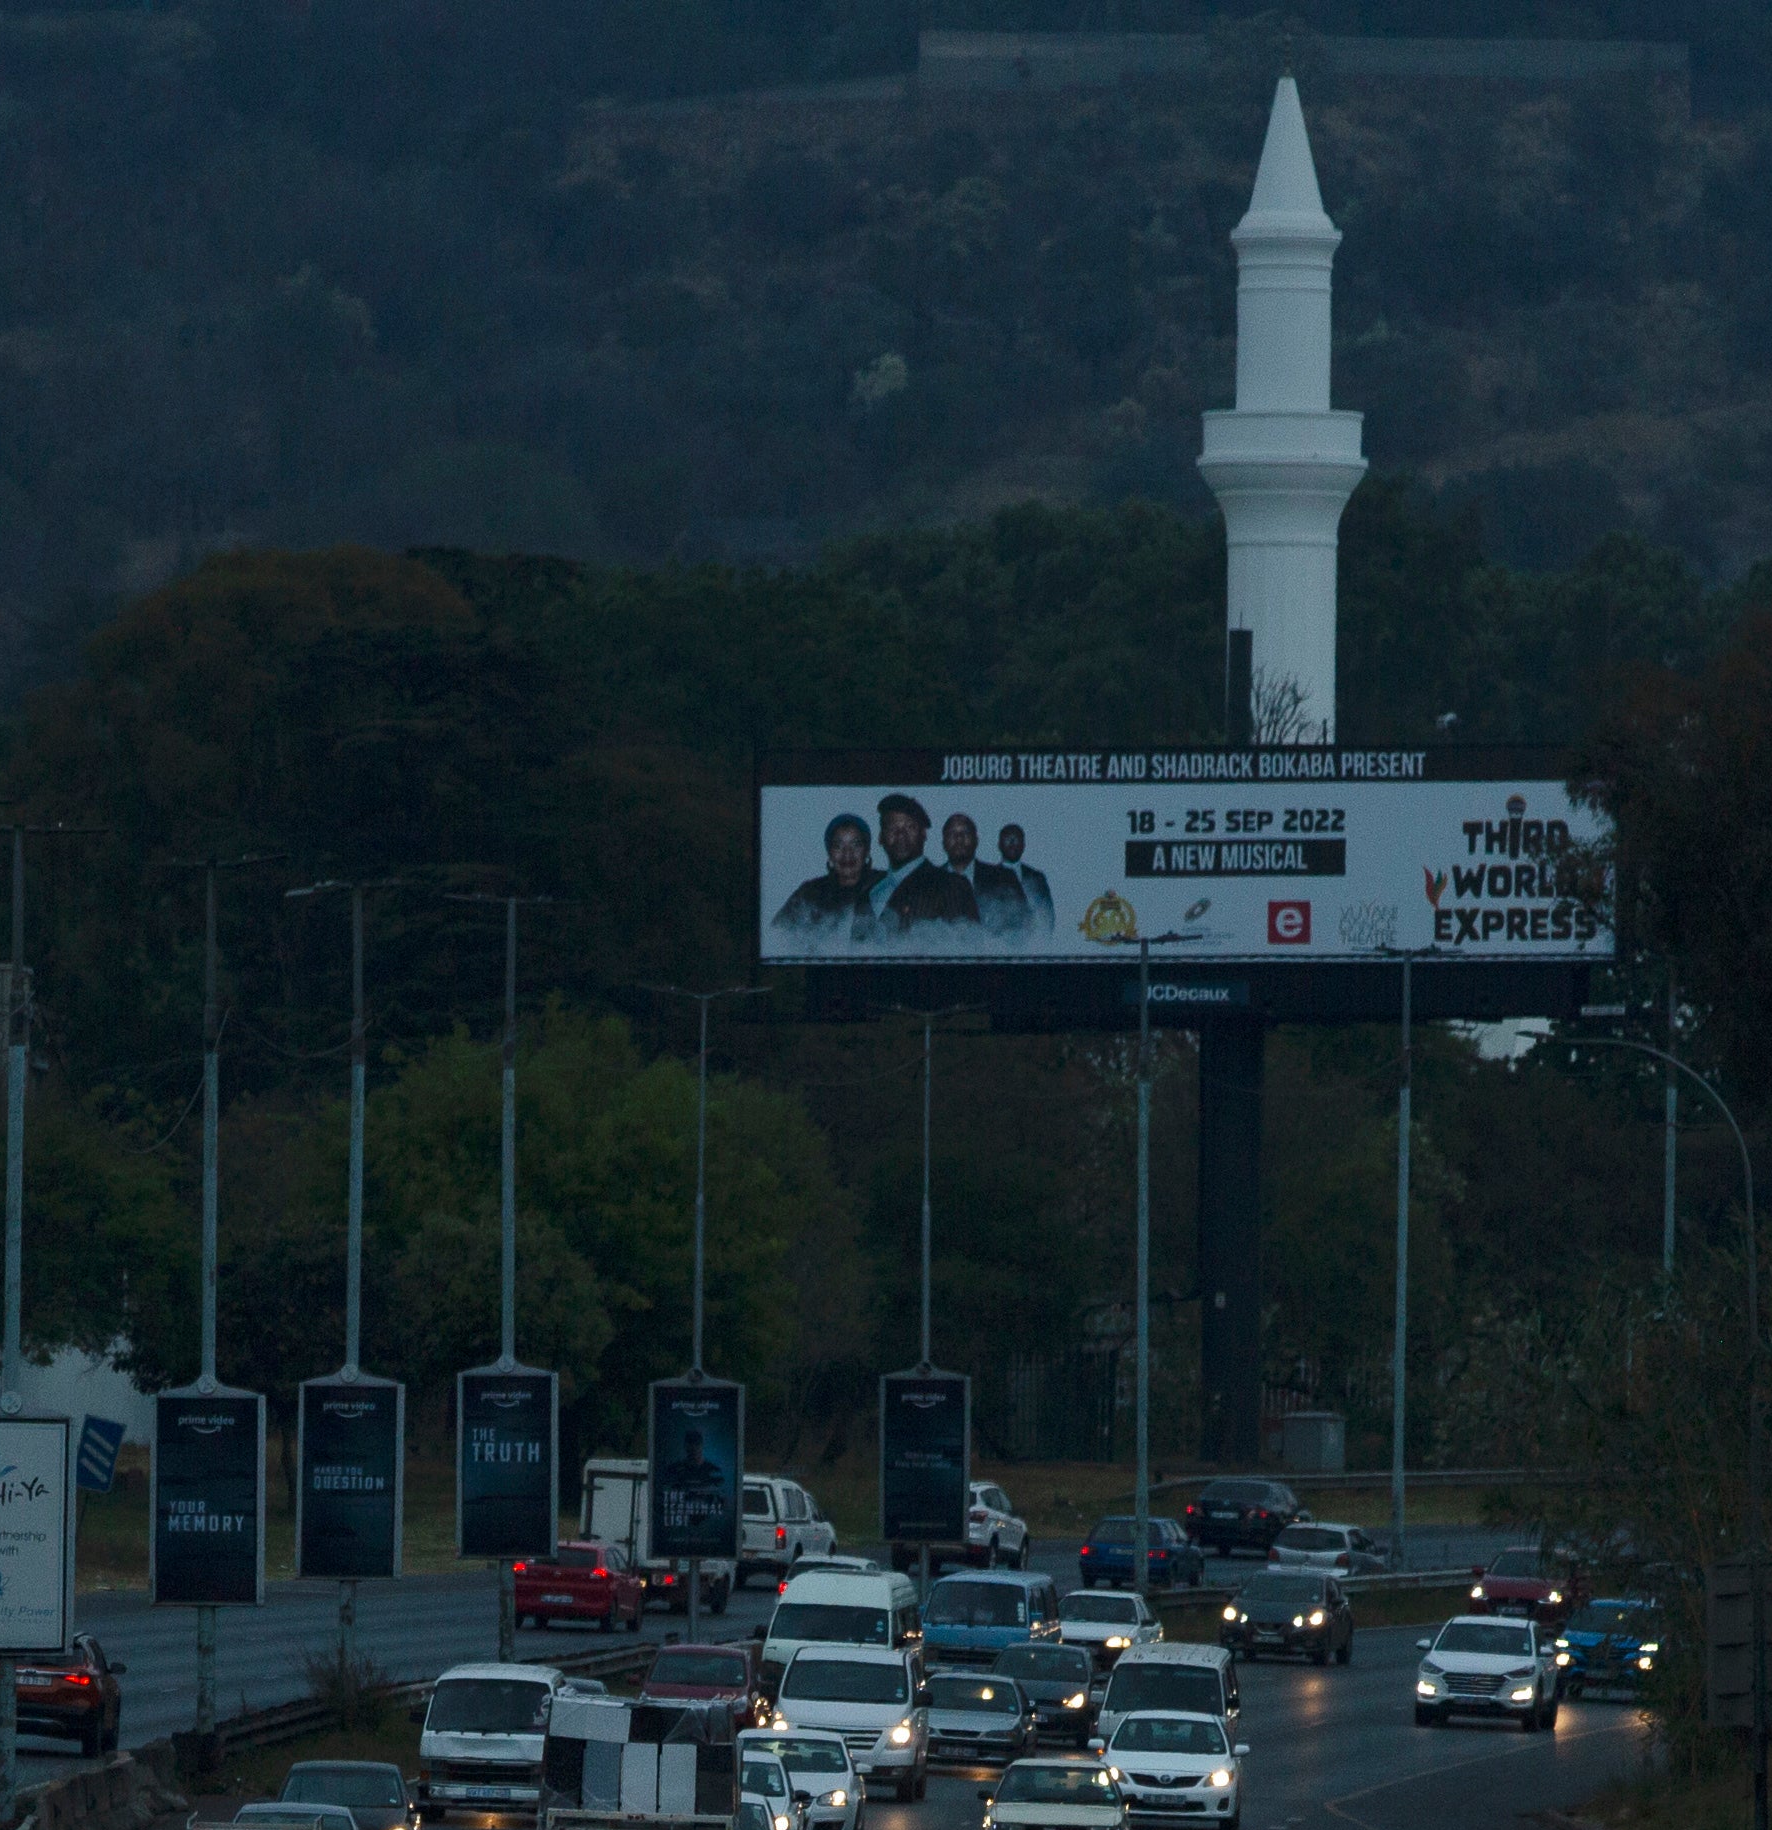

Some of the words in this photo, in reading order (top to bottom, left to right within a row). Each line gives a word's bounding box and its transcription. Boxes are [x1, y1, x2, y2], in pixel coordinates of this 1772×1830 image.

[940, 756, 1012, 781] JOBURG
[1018, 755, 1103, 780] THEATRE
[1107, 755, 1146, 780] AND
[1151, 753, 1253, 779] SHADRACK
[1258, 752, 1336, 779] BOKABA
[1340, 751, 1427, 779] PRESENT
[1126, 810, 1156, 834] 18
[1184, 809, 1216, 833] 25
[1225, 809, 1273, 833] SEP
[1282, 808, 1346, 833] 2022
[1461, 818, 1570, 860] THIRD
[1152, 844, 1166, 871] A
[1170, 843, 1217, 871] NEW
[1221, 842, 1308, 870] MUSICAL
[1433, 907, 1597, 945] EXPRESS
[177, 1415, 207, 1427] prime
[208, 1415, 236, 1425] video
[472, 1427, 497, 1441] THE
[471, 1441, 541, 1463] TRUTH
[313, 1475, 385, 1490] QUESTION
[168, 1500, 206, 1514] YOUR
[168, 1514, 245, 1532] MEMORY
